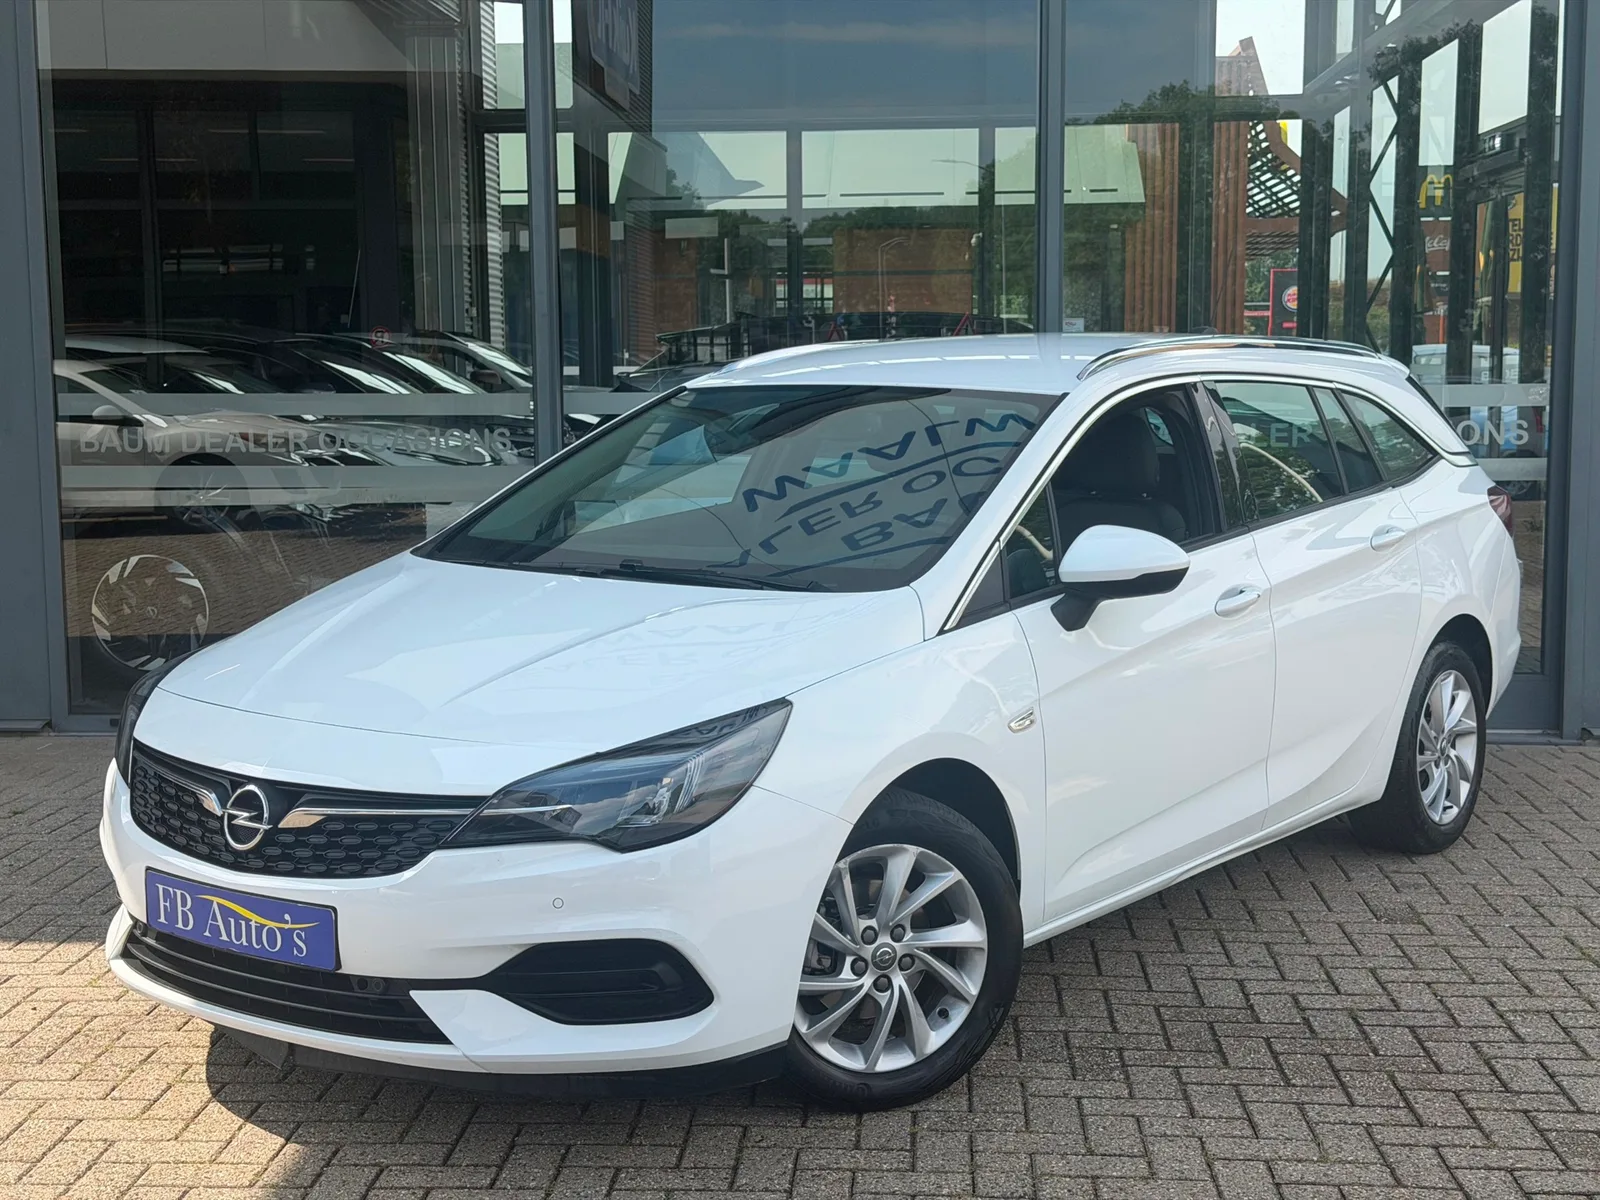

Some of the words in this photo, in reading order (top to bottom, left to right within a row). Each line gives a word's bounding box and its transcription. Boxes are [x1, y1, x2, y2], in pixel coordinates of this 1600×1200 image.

[80, 427, 171, 453] BAUM
[181, 429, 308, 453] DEALER
[319, 427, 511, 453] OCCASIONS
[155, 883, 195, 931] FB
[203, 901, 307, 957] Auto's
